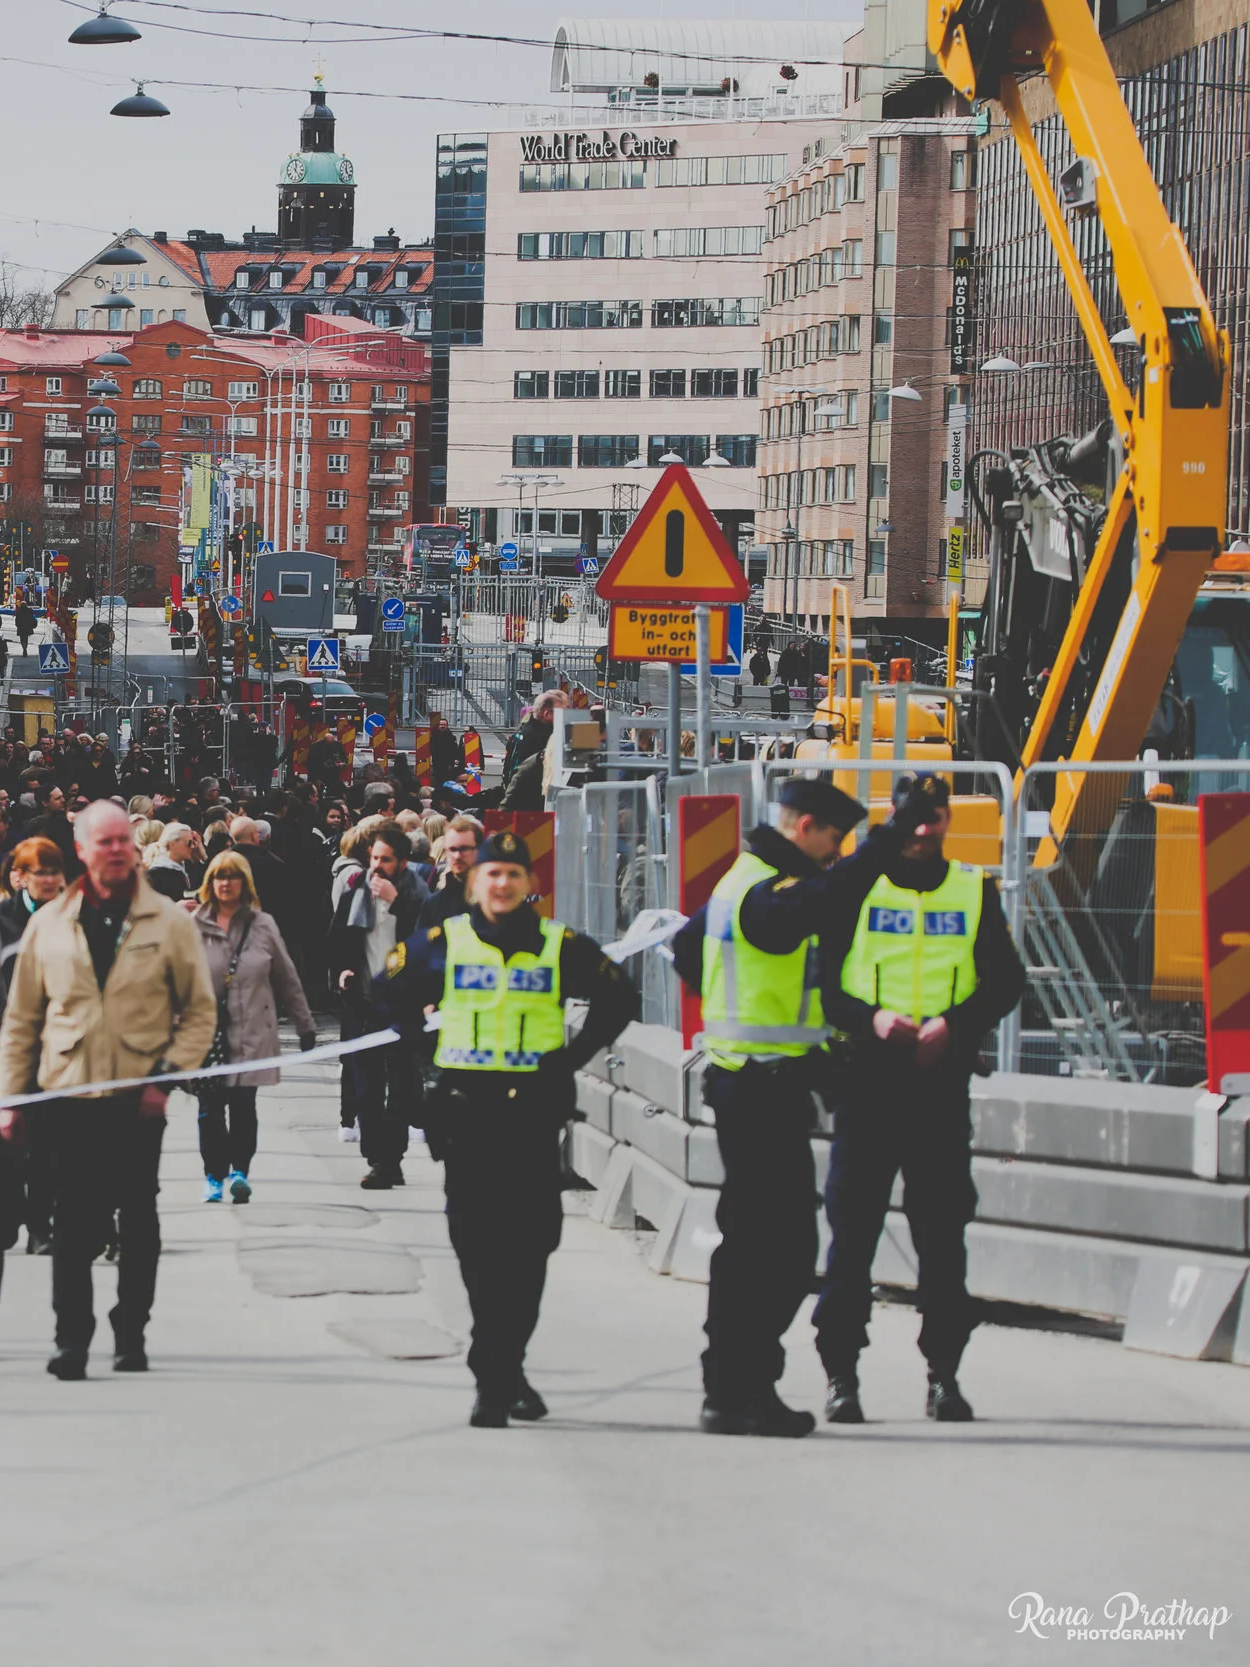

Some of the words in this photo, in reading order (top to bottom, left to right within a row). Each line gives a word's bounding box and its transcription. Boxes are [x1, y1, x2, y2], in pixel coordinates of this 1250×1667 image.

[520, 132, 568, 162] World
[569, 131, 614, 160] Trade
[618, 131, 677, 158] Center
[953, 276, 968, 364] McDonald's
[952, 431, 961, 478] apoteket
[949, 533, 961, 569] Hertz
[629, 610, 697, 626] Byggtraf
[647, 645, 690, 656] utfart
[876, 909, 960, 933] POLIS
[461, 965, 545, 991] POLIS
